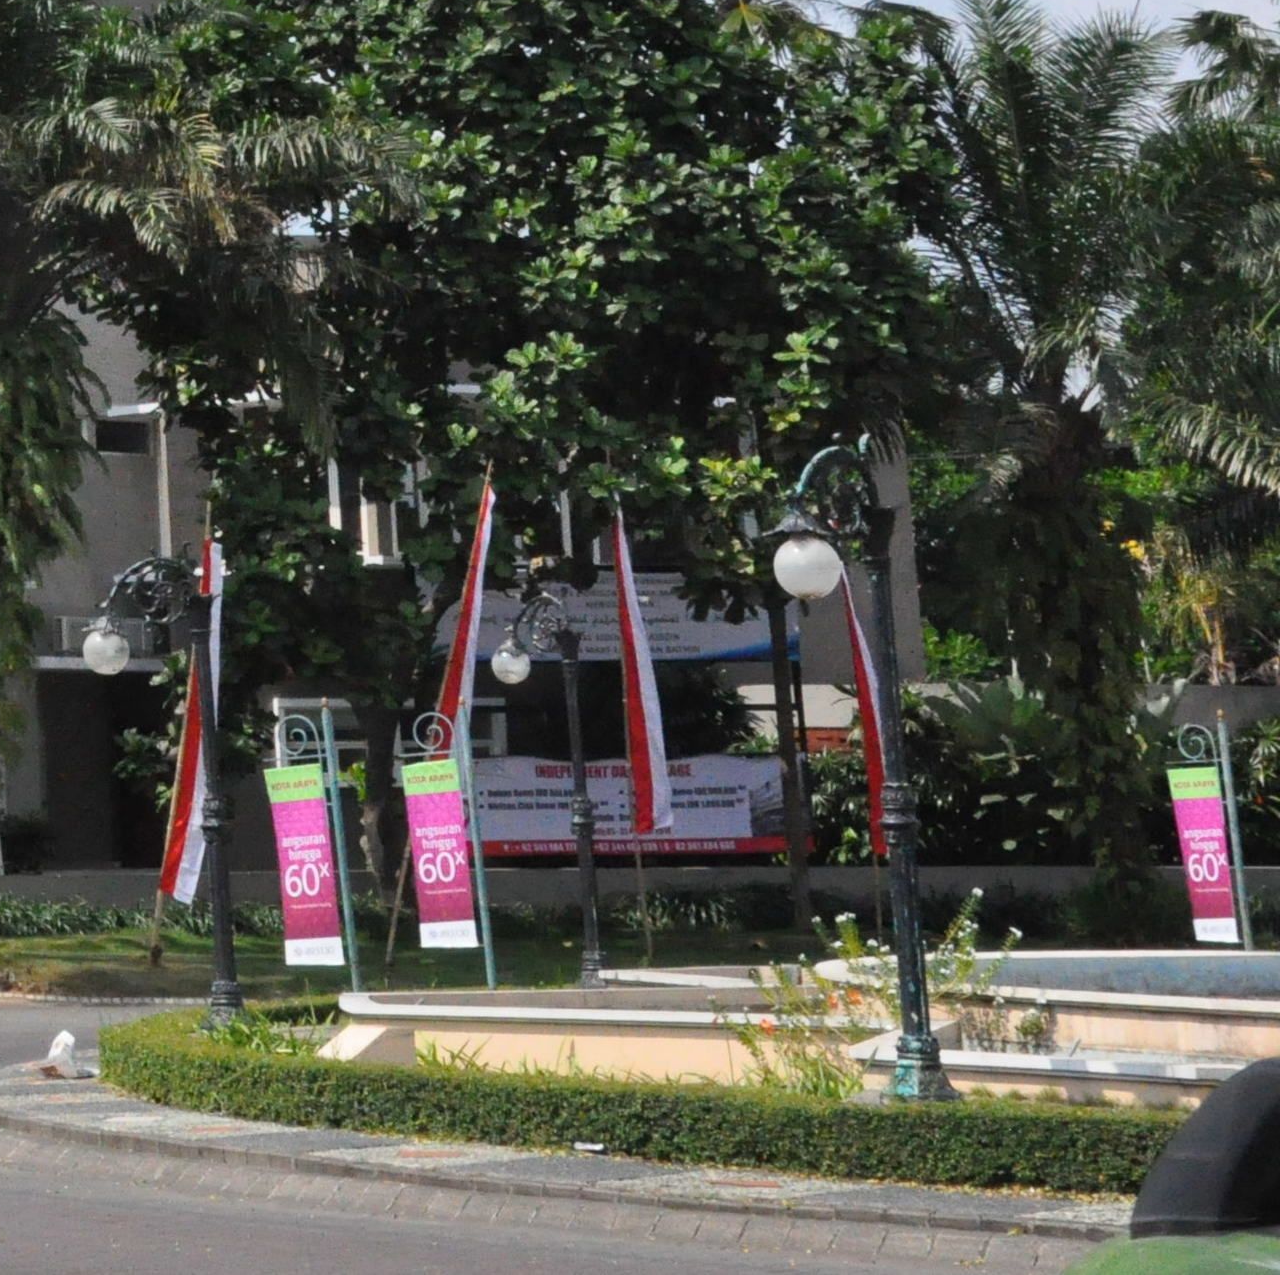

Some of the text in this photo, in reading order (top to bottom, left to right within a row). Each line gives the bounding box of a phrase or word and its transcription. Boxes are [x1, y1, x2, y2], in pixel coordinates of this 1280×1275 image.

[535, 765, 608, 780] INDEPEENT
[415, 825, 461, 840] angsuran
[281, 834, 326, 851] angsuran
[422, 837, 457, 851] hingga
[288, 848, 322, 862] hingga
